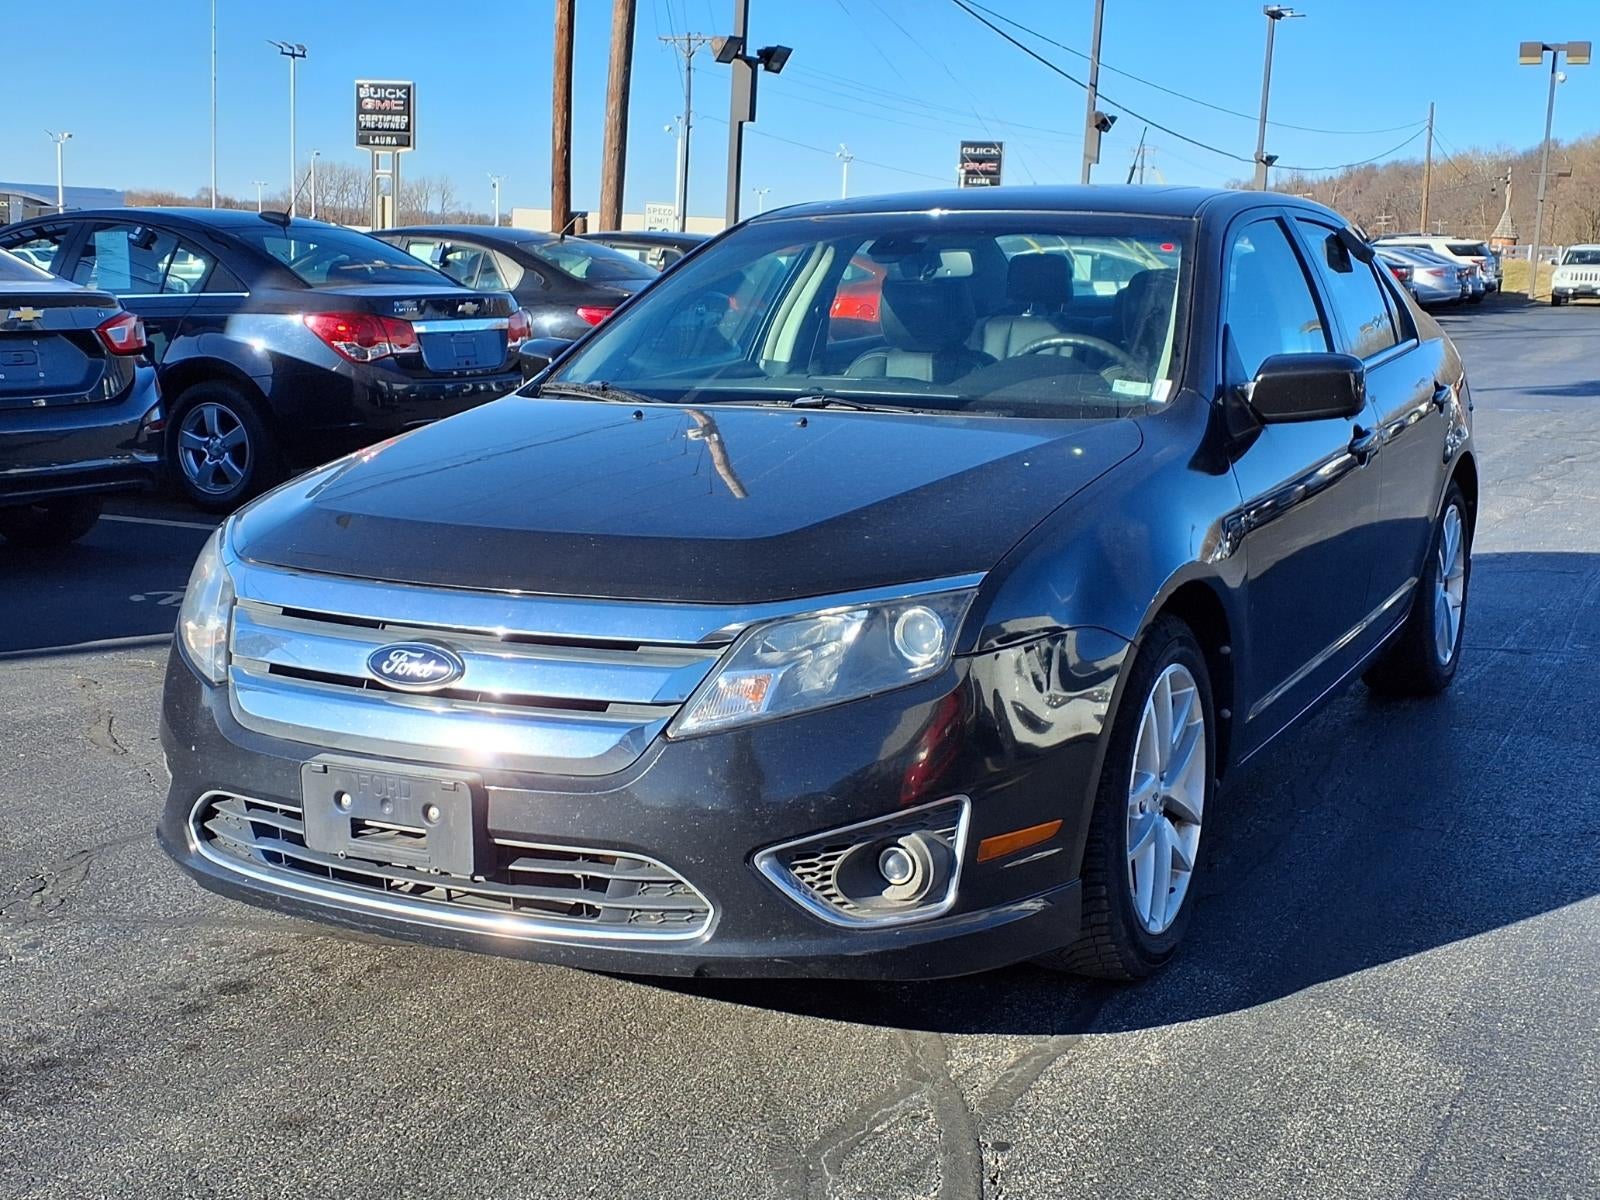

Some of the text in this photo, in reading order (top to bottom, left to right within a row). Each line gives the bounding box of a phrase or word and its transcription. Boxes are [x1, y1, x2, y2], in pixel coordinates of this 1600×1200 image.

[359, 87, 407, 98] BUICK
[361, 98, 404, 110] GMC
[359, 114, 408, 122] CERTIFIED
[360, 121, 406, 129] PRE-OWNED
[369, 135, 397, 145] LAURA
[962, 147, 999, 155] BUICK
[963, 162, 998, 170] GMC
[968, 177, 991, 185] LAURA
[647, 207, 673, 216] SPEED
[649, 216, 670, 225] LIMIT
[381, 649, 436, 678] Ford
[357, 773, 413, 800] FORD
